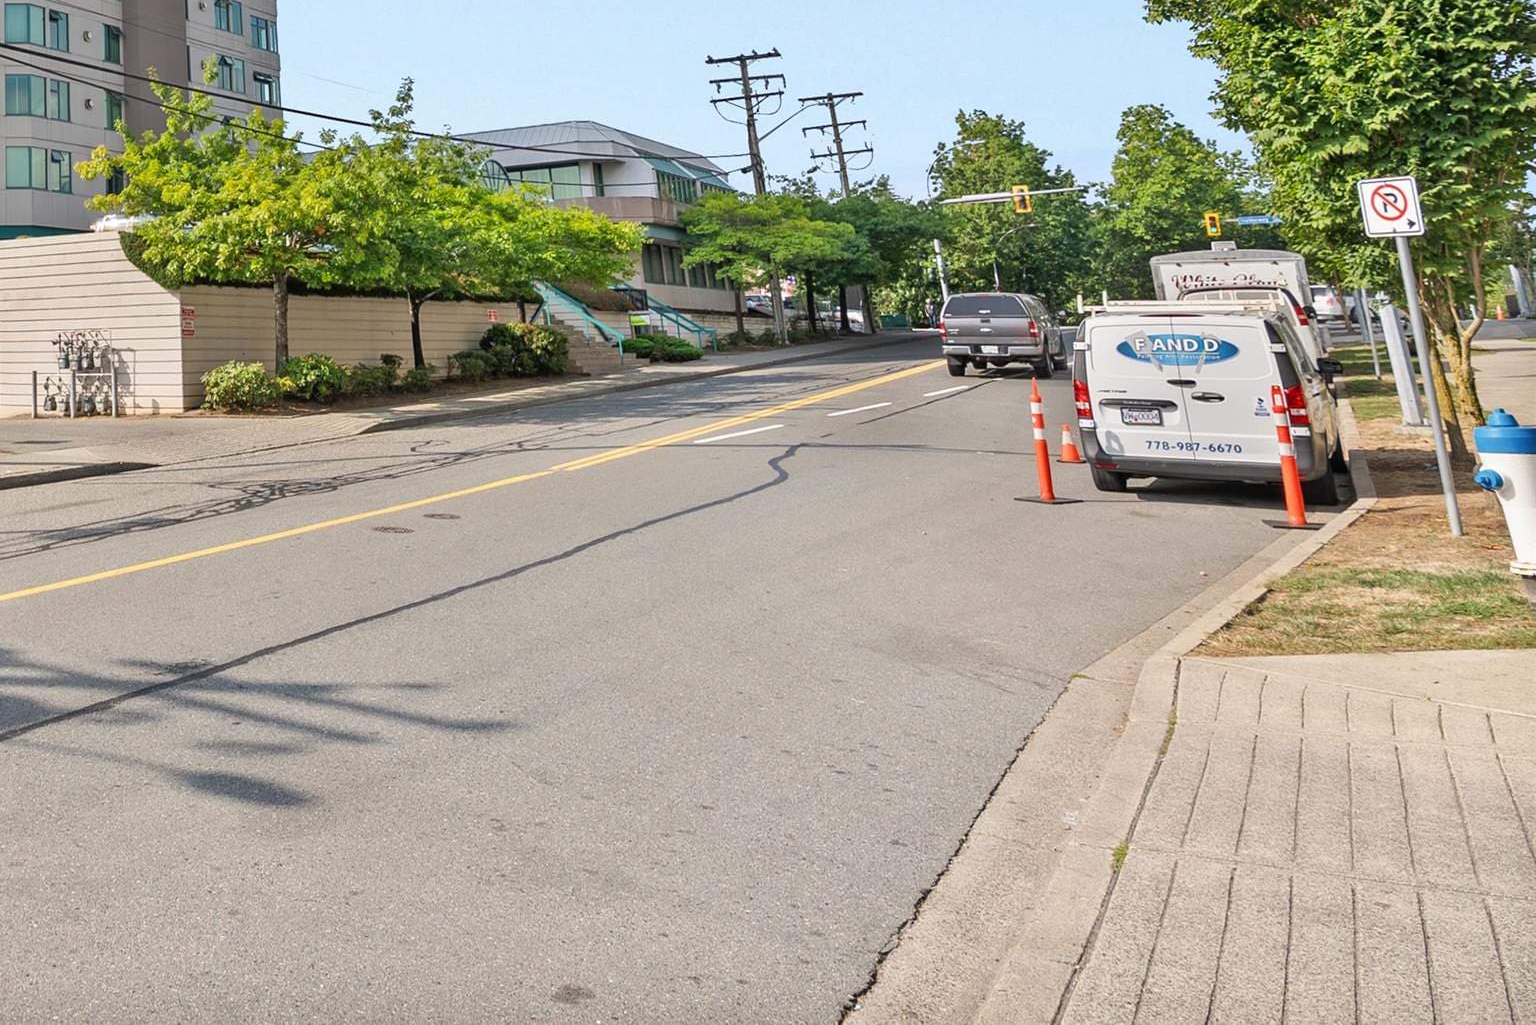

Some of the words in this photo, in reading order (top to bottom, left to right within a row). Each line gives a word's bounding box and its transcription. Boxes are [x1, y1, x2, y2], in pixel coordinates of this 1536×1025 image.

[1135, 338, 1145, 351] F
[1152, 338, 1199, 352] AND
[1204, 338, 1219, 352] D
[1145, 440, 1242, 454] 778-987-6670
